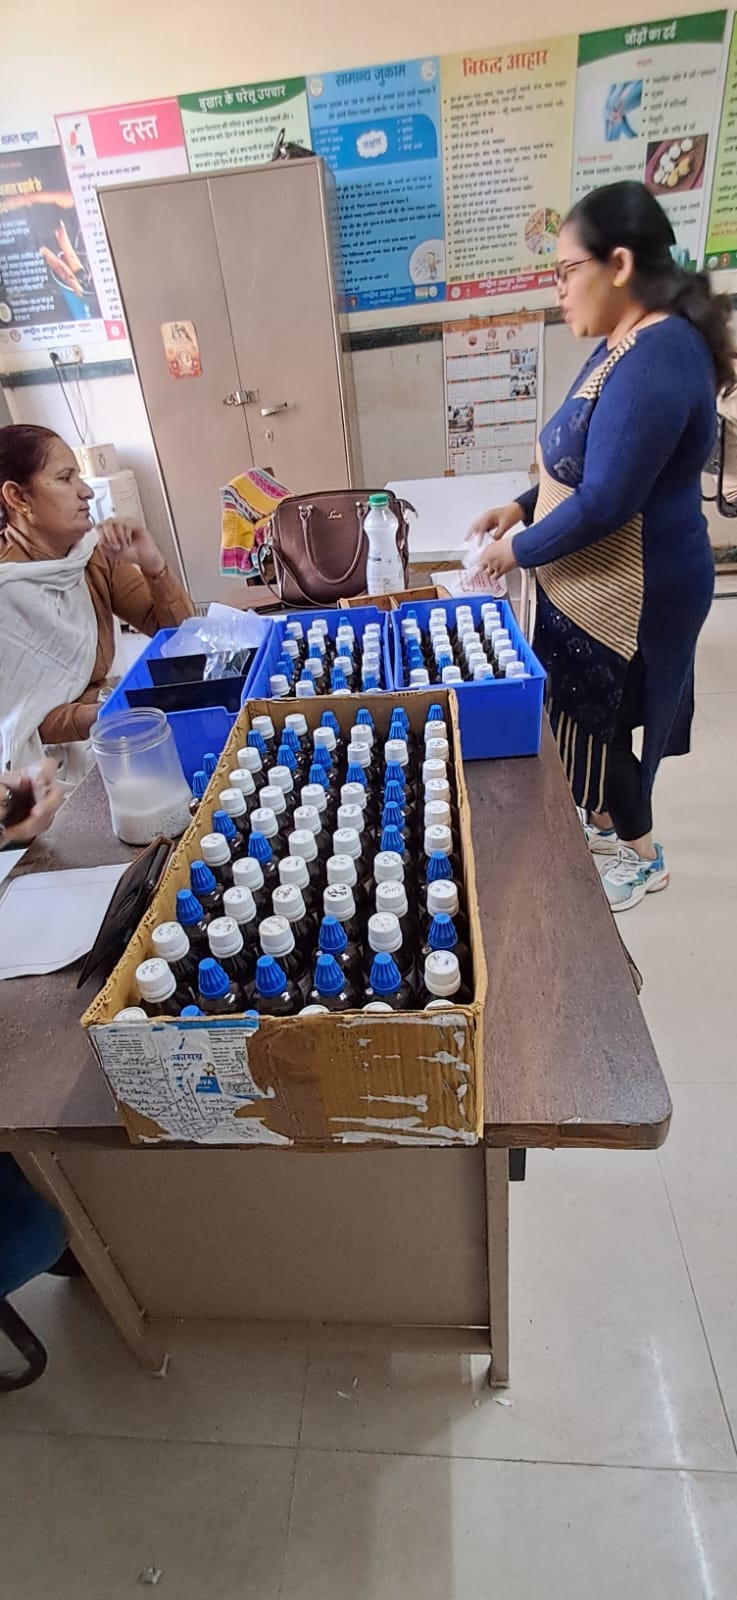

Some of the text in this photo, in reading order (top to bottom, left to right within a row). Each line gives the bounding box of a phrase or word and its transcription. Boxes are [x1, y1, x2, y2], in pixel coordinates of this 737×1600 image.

[624, 24, 677, 46] जोड़ों का दर्द
[335, 64, 406, 87] सामान्य जुकाम
[462, 48, 549, 77] विरुद्ध आहार
[198, 85, 287, 113] बुखार के घरेलू उपचार
[118, 115, 159, 145] दस्त
